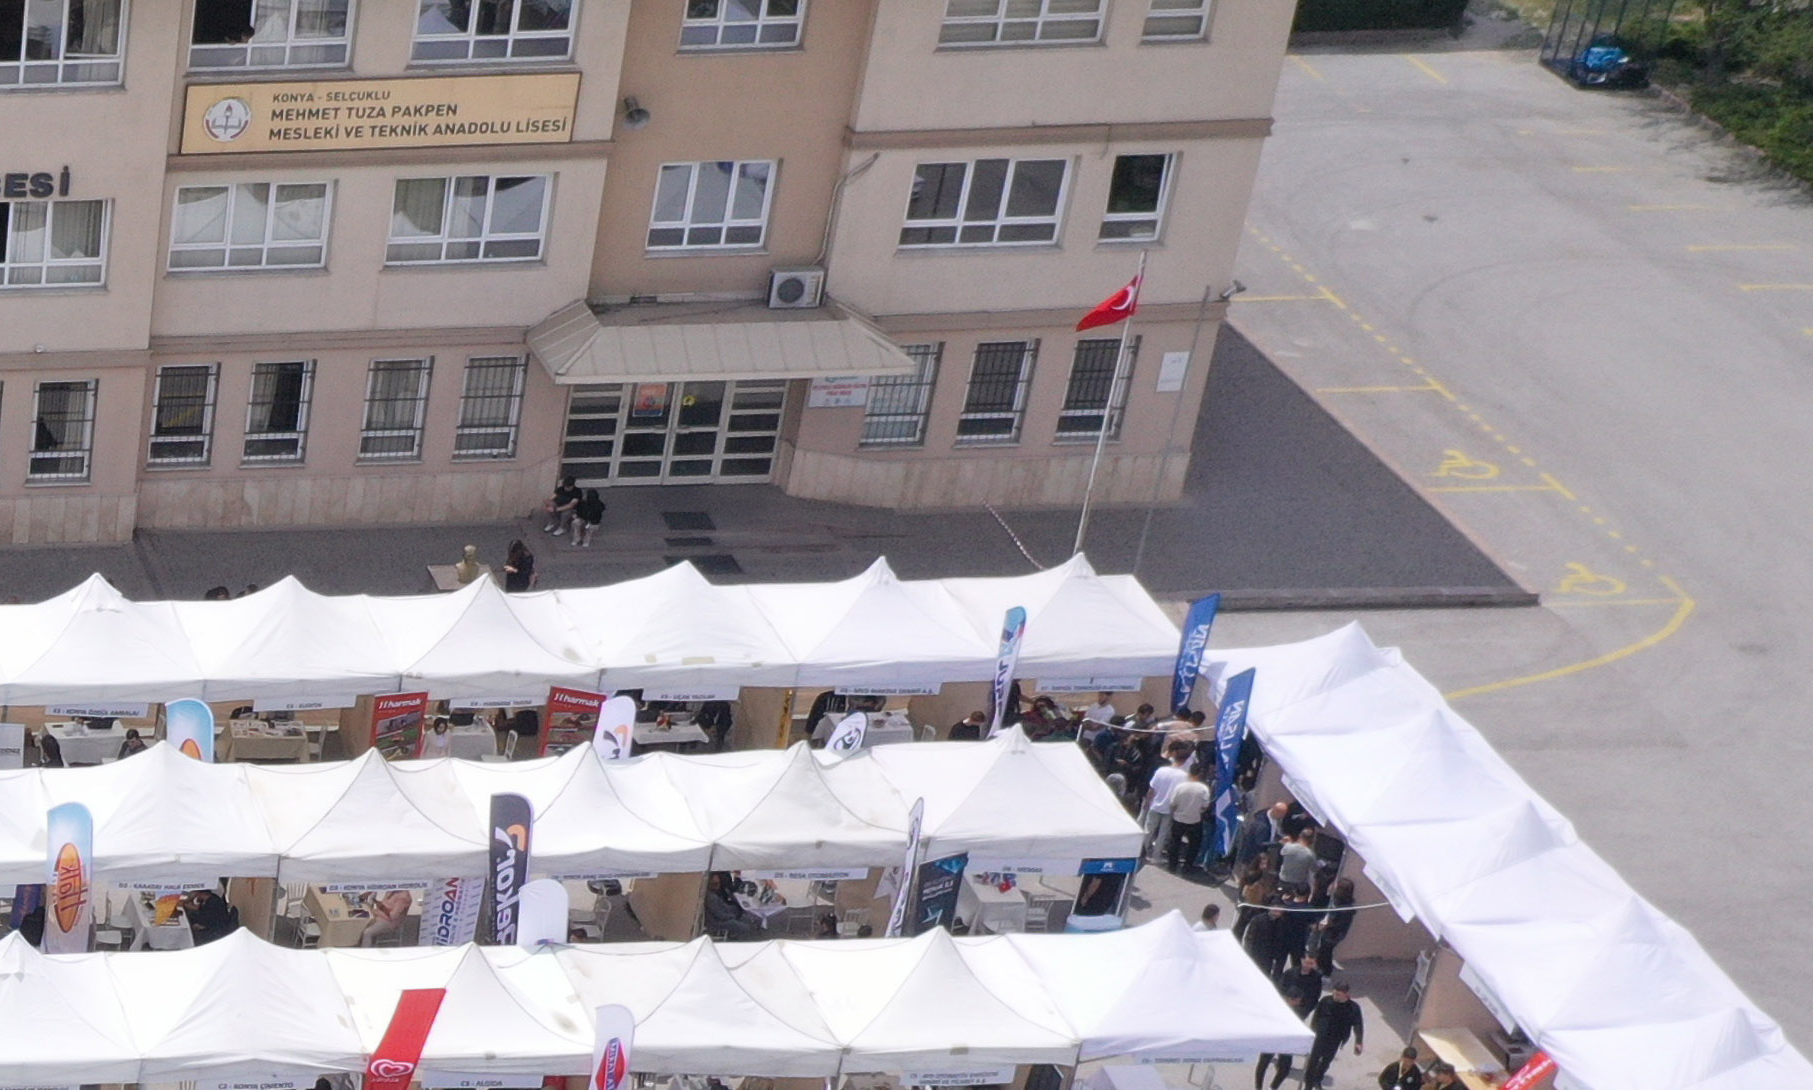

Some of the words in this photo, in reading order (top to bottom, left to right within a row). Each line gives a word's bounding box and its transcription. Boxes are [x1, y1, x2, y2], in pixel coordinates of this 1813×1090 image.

[272, 93, 315, 103] KONYA
[326, 91, 391, 103] SELÇUKLU
[270, 107, 341, 121] MEHMET
[346, 106, 386, 119] TUZA
[391, 104, 458, 118] PAKPEN
[268, 125, 340, 140] MESLEKİ
[344, 125, 364, 138] VE
[369, 123, 428, 137] TEKNİK
[432, 121, 511, 136] ANADOLU
[516, 116, 567, 134] LİSESİ
